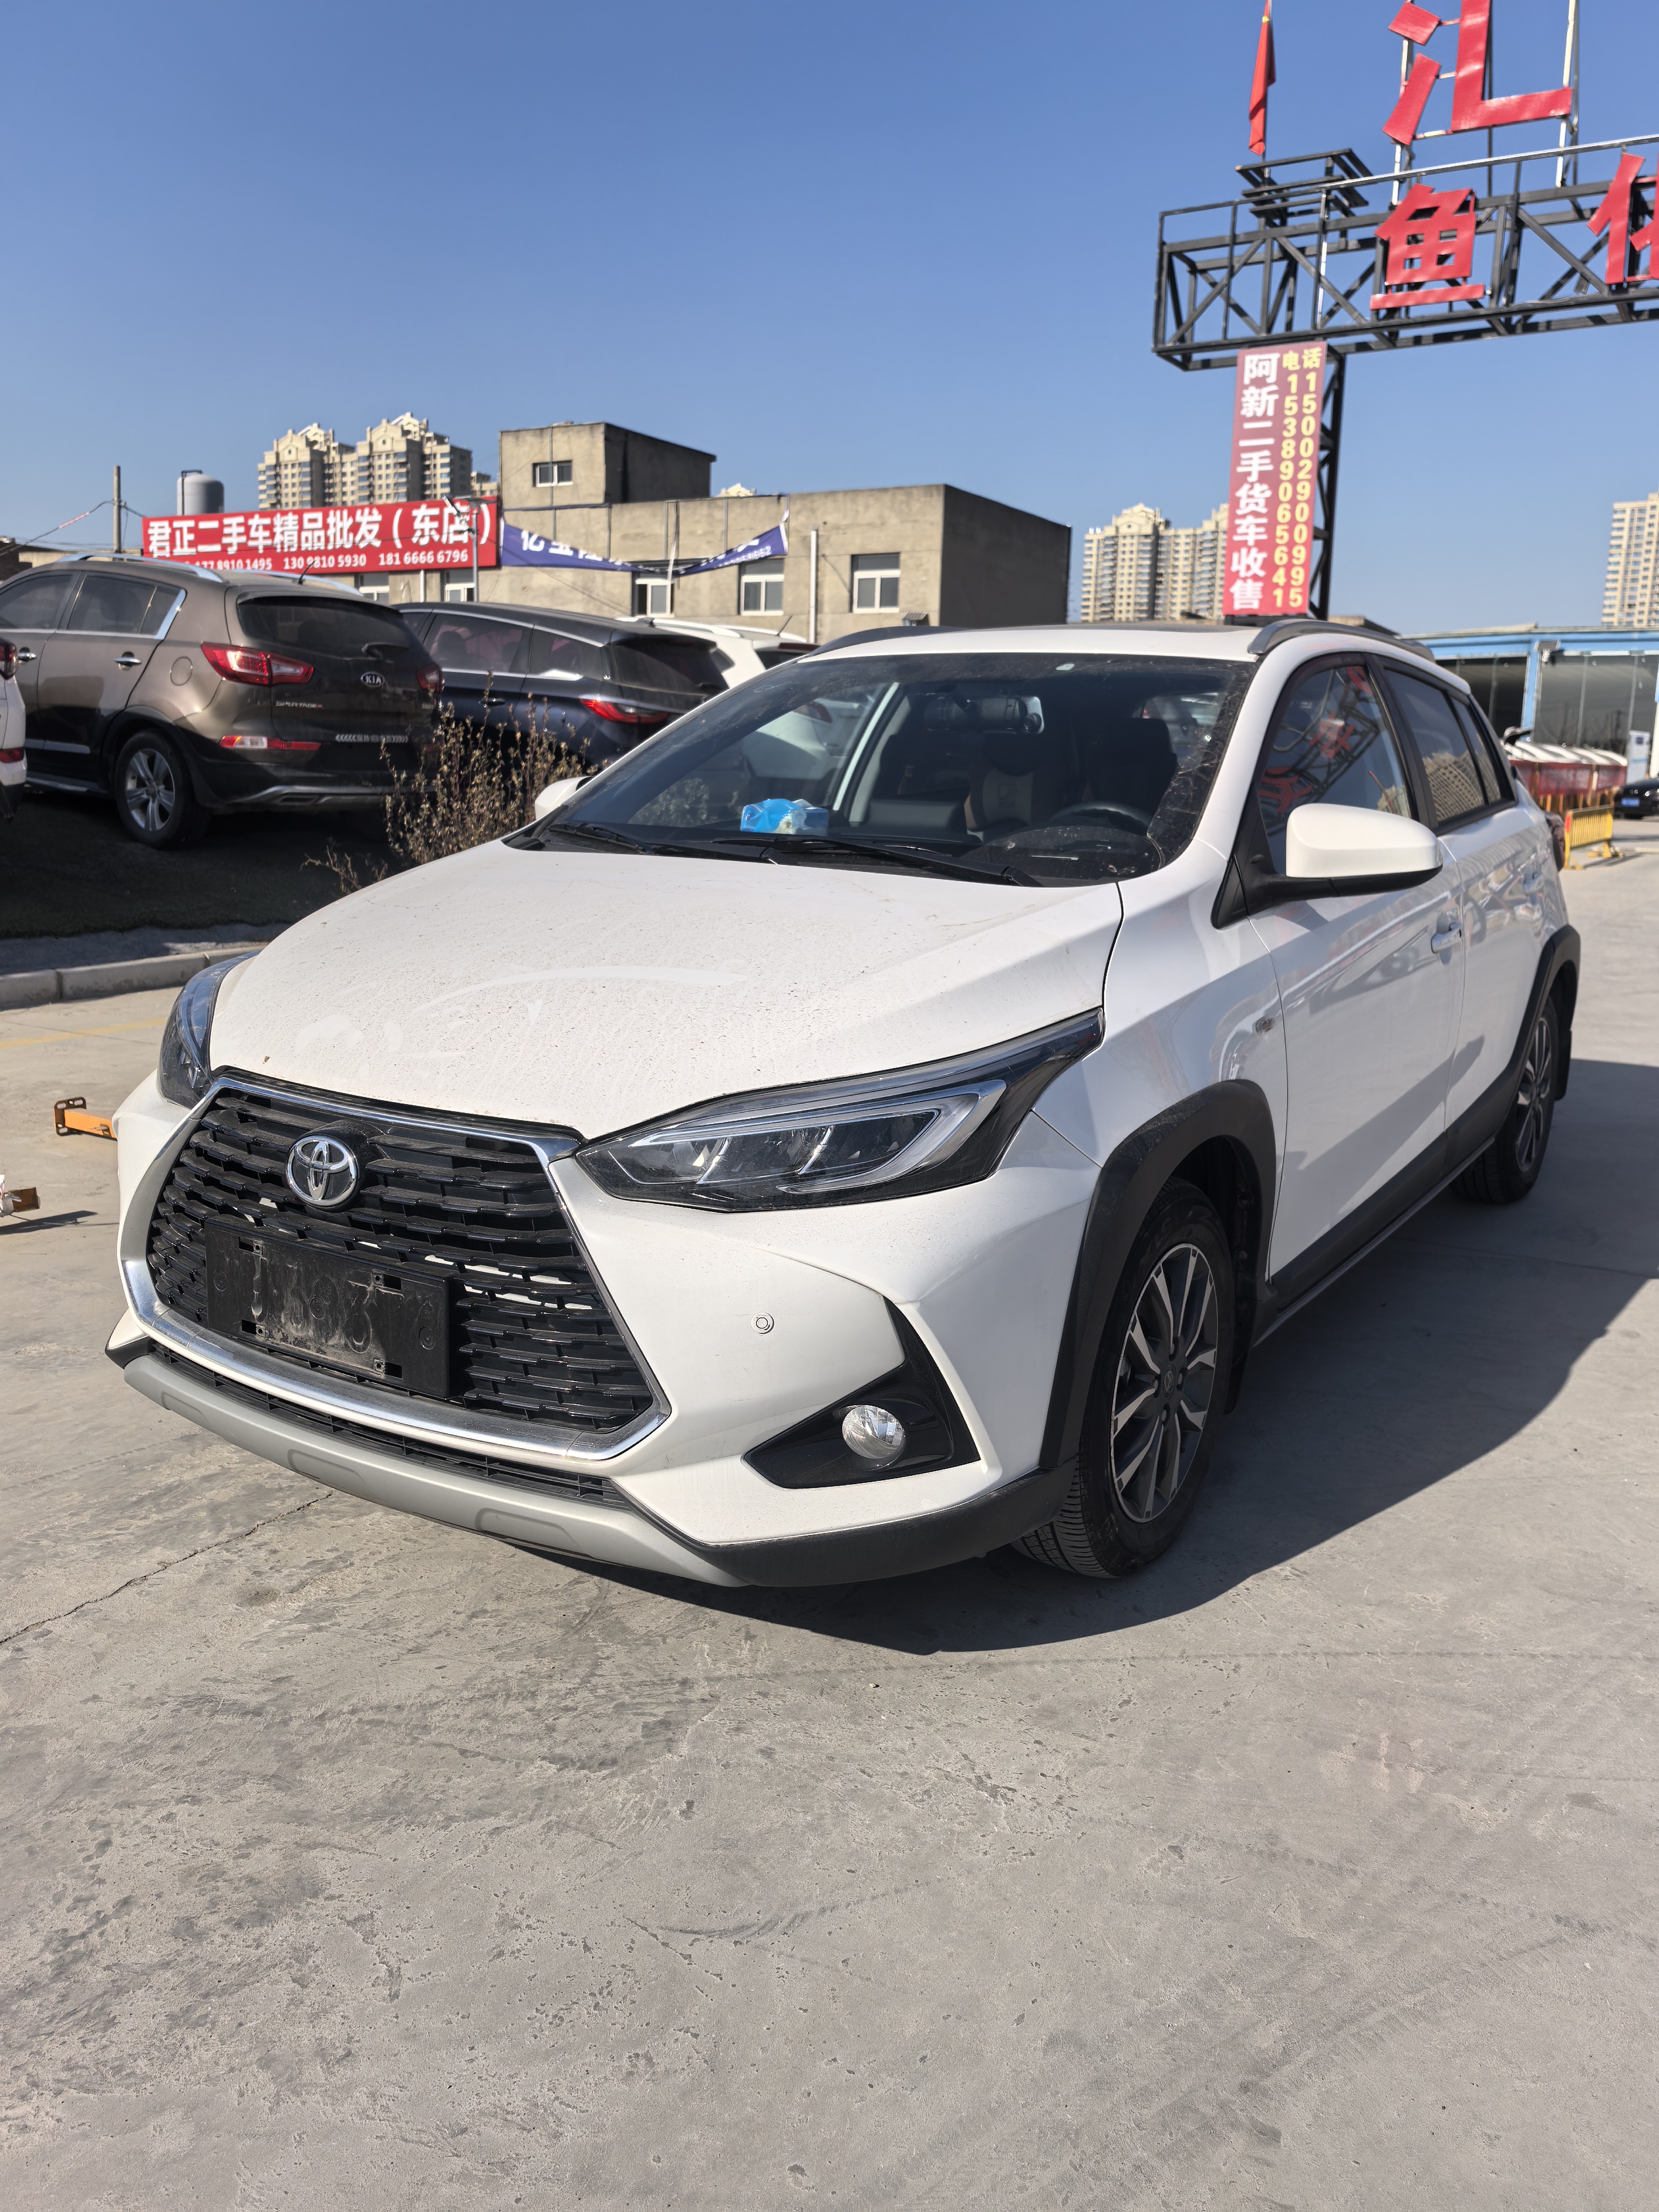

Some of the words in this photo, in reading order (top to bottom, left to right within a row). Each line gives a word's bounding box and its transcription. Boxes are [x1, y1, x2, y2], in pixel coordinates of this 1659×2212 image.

[1282, 348, 1322, 371] 电话
[1229, 353, 1280, 610] 阿新二手货车收售
[1272, 373, 1299, 608] 15389065641
[1289, 372, 1317, 608] 15002900995
[245, 557, 272, 571] 1495
[284, 557, 304, 570] 130
[306, 555, 335, 568] 9810
[337, 554, 366, 568] 5930
[379, 552, 401, 566] 181
[403, 551, 434, 565] 6666
[436, 549, 468, 563] 6796
[366, 675, 382, 684] KIA
